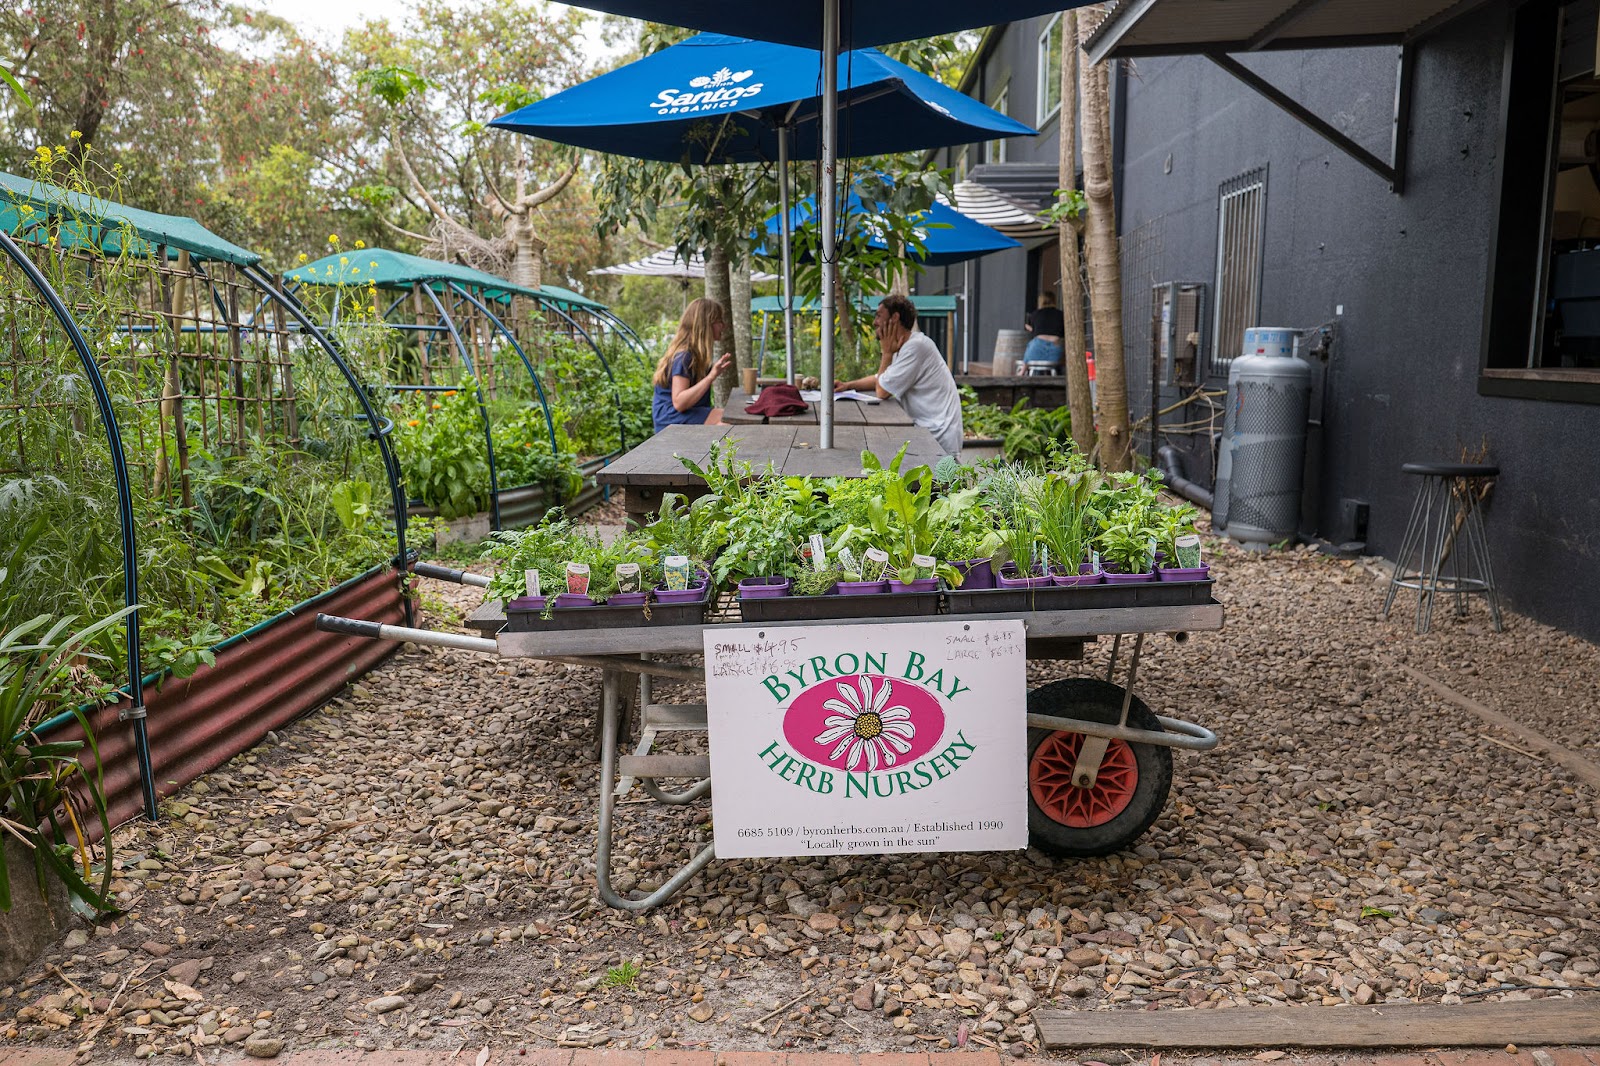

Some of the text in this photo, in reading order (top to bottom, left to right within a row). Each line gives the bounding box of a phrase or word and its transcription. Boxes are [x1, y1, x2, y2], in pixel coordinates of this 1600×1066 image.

[650, 83, 764, 108] Santos
[657, 100, 739, 115] ORGANICS
[714, 643, 751, 655] SMALL
[753, 637, 807, 657] $4.95
[946, 635, 976, 645] SMALL
[947, 649, 981, 661] LARGE
[759, 650, 972, 704] BYRON BAY
[756, 729, 978, 799] HERB NURSERY
[737, 827, 764, 838] 6685
[767, 826, 794, 837] 5109
[803, 824, 904, 839] byronherbs.com.au
[913, 821, 974, 832] Established
[978, 820, 1004, 830] 1990
[847, 839, 880, 851] grown
[883, 837, 894, 847] in
[897, 837, 914, 846] the
